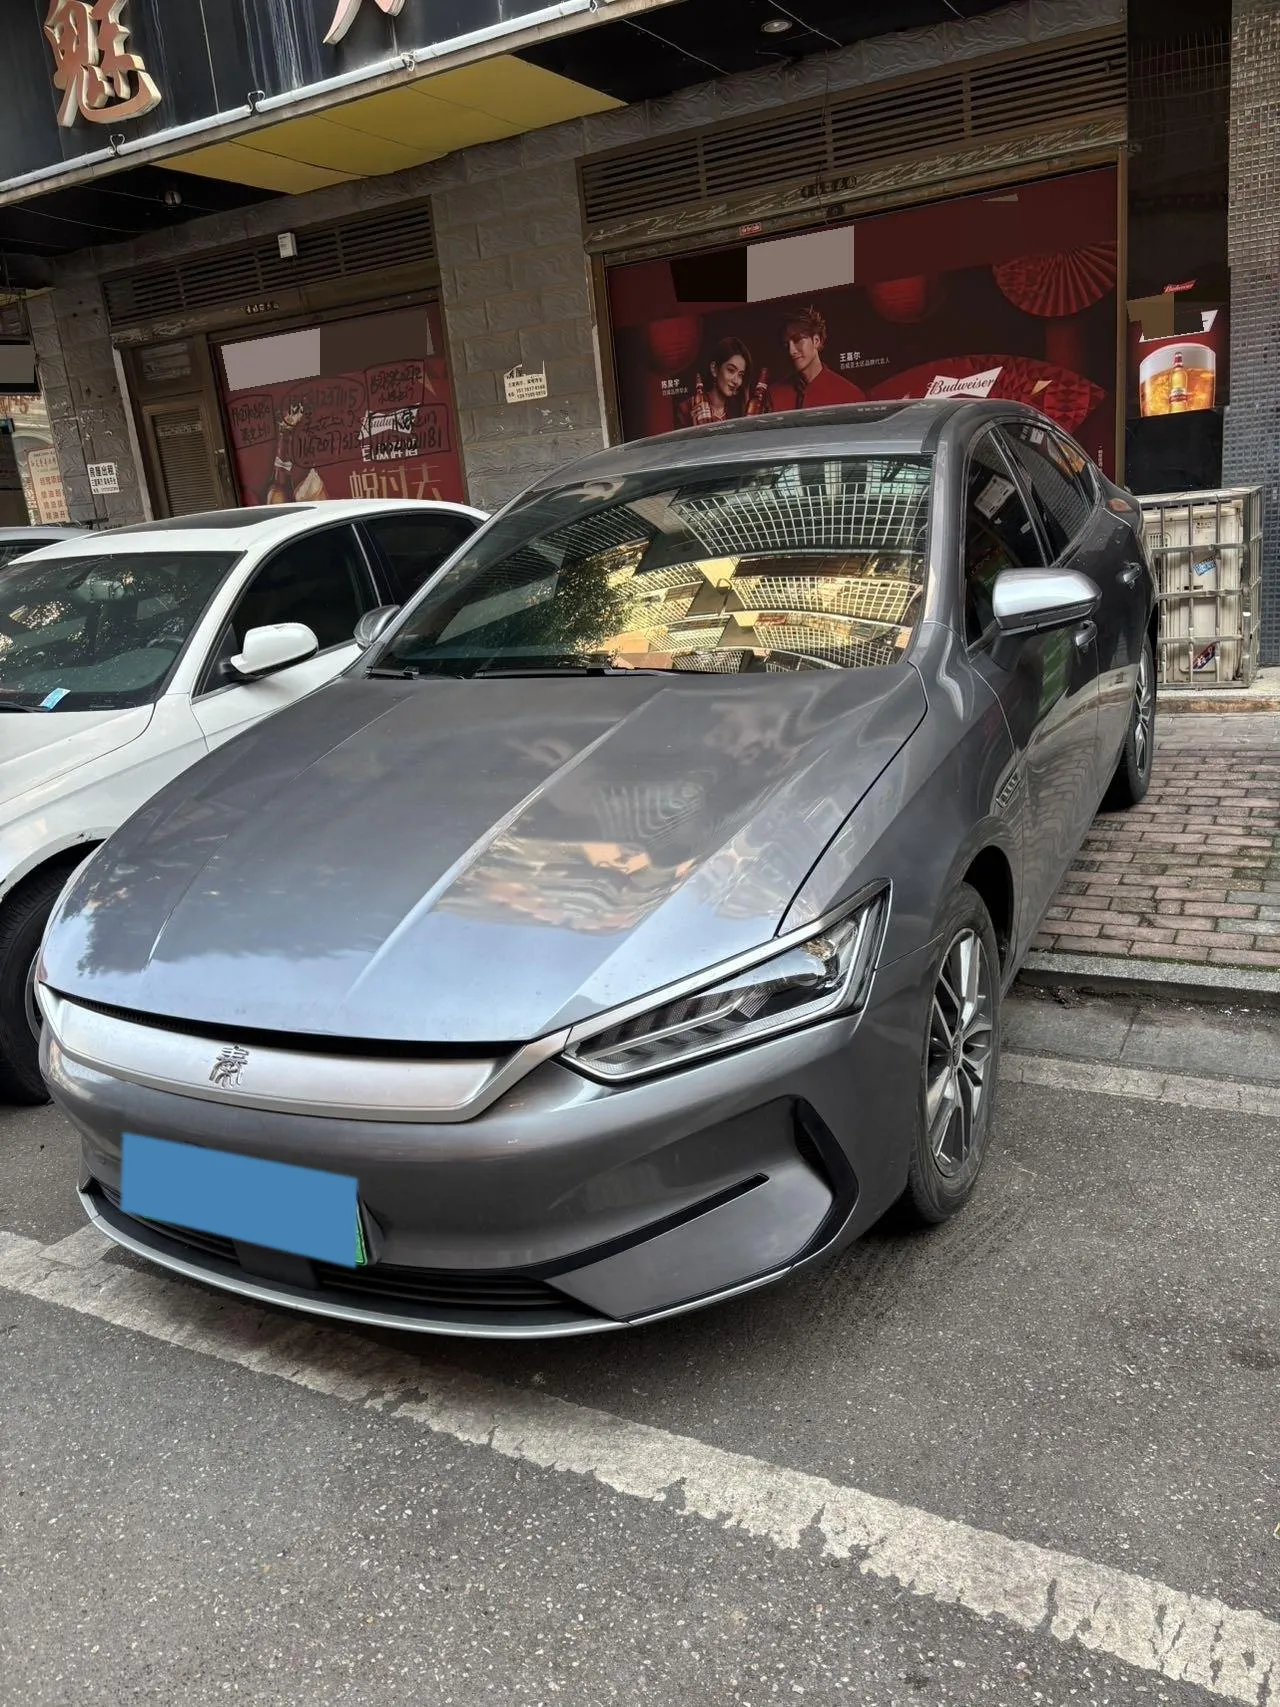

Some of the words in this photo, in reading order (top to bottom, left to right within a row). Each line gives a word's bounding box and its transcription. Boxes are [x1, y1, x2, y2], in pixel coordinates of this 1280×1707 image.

[840, 351, 860, 362] 王嘉尔
[927, 378, 995, 396] Budweiser
[90, 464, 115, 478] 房屋出租
